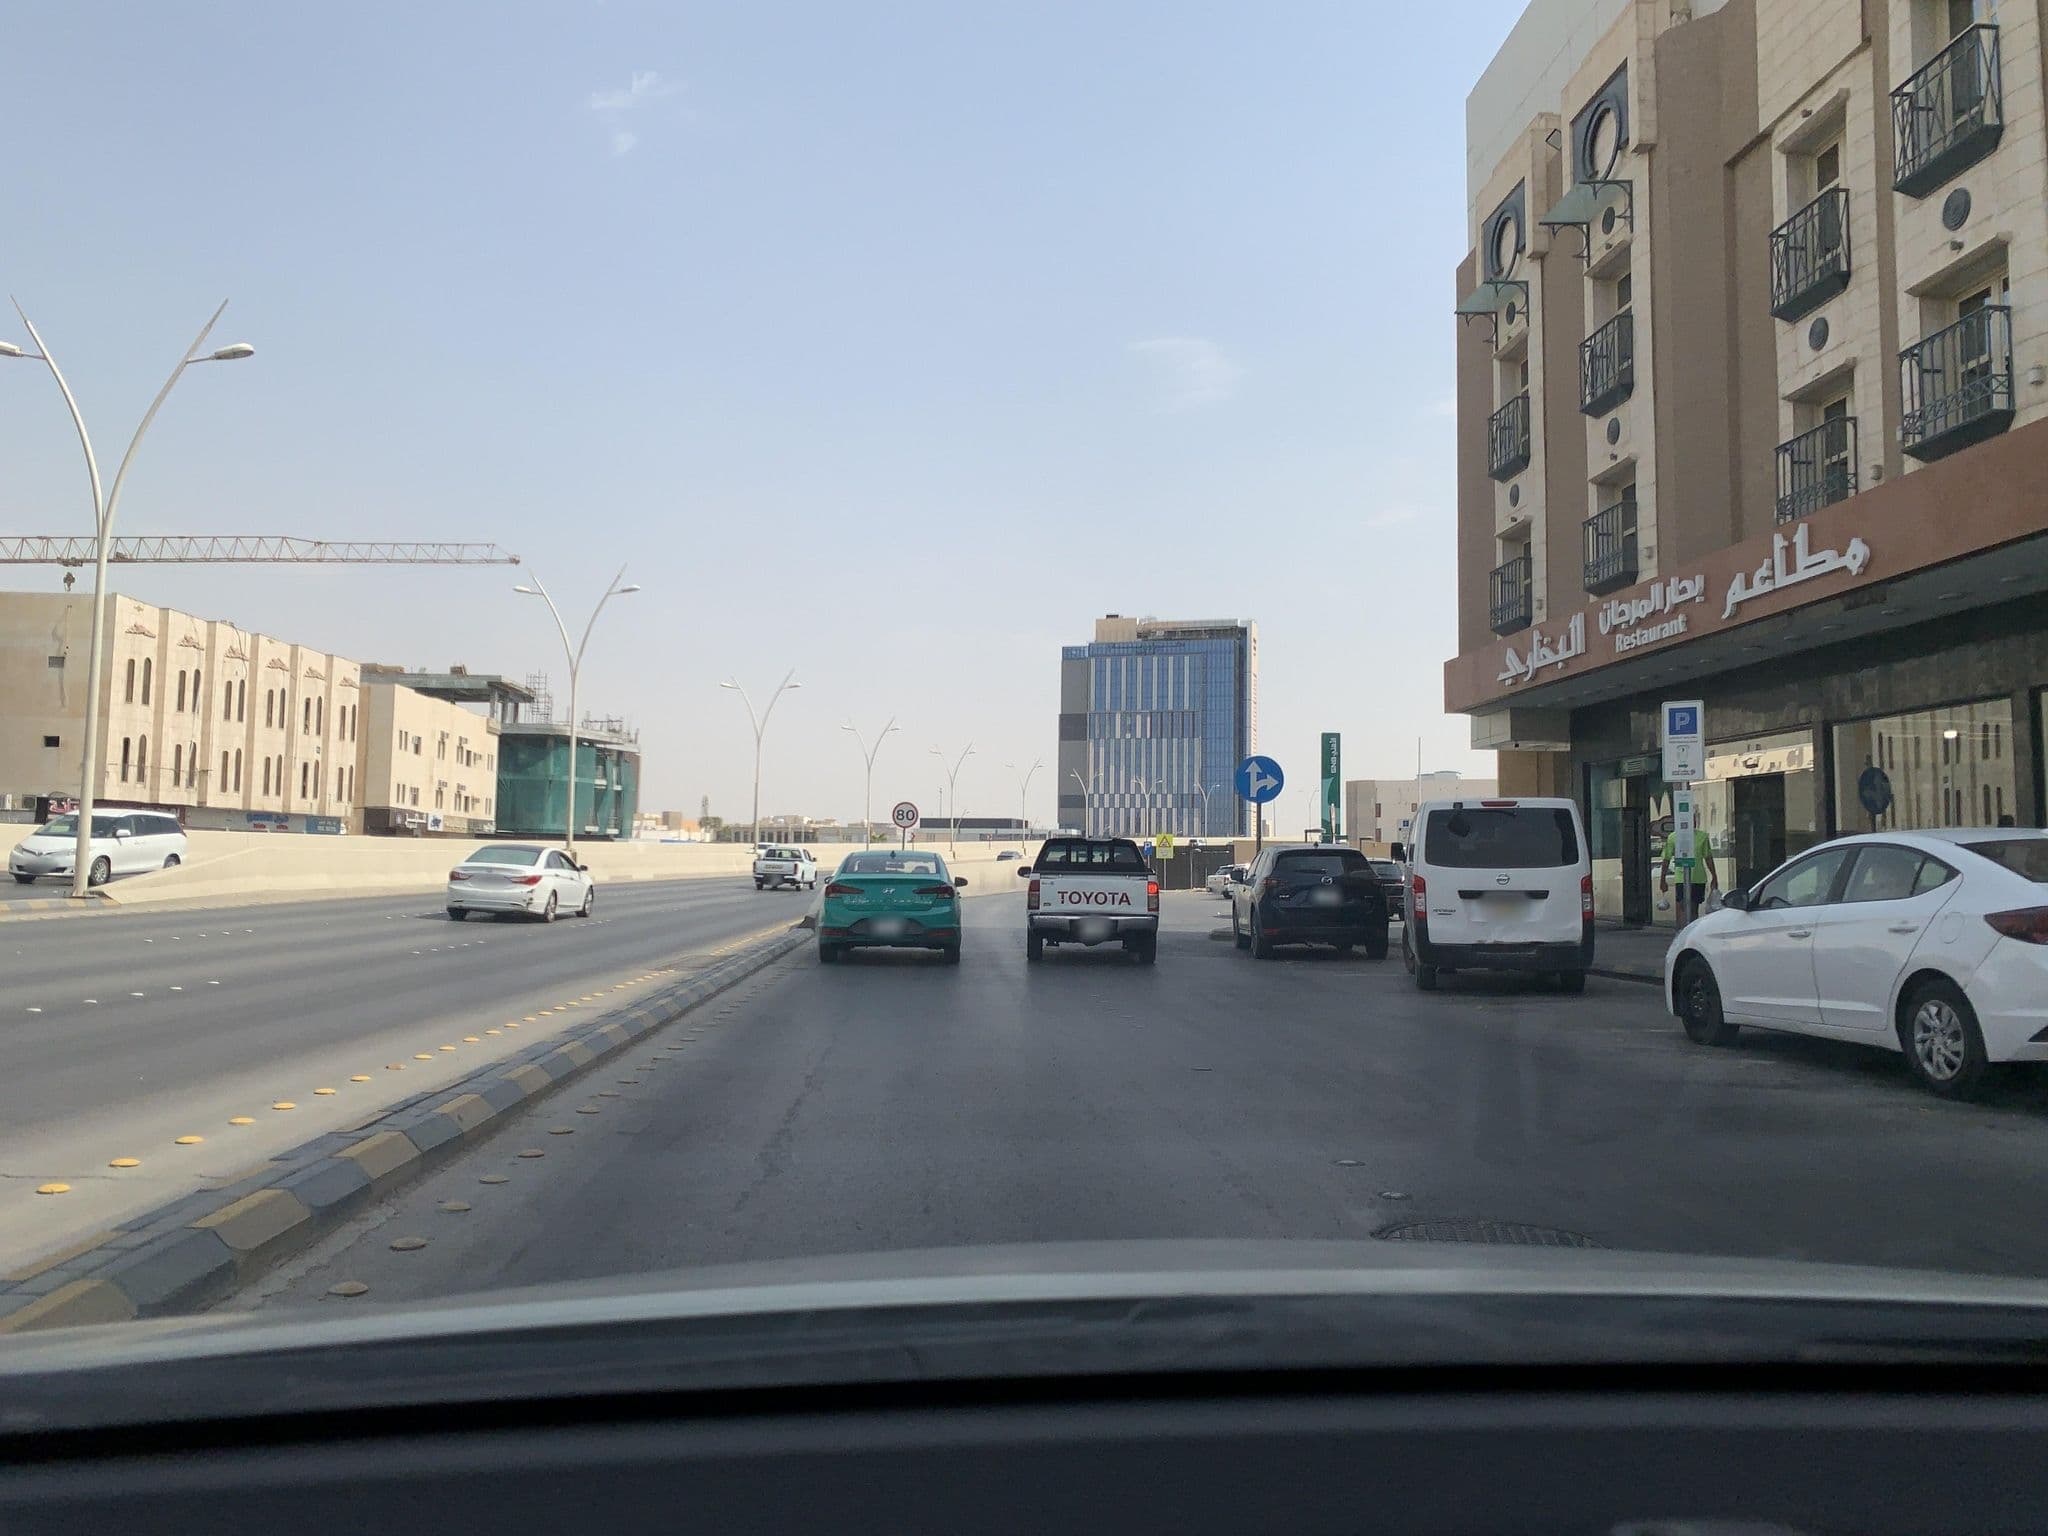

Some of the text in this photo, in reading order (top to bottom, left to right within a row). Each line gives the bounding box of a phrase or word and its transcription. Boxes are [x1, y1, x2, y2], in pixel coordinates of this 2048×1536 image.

[1721, 522, 1871, 620] مطاعم
[1599, 582, 1664, 635] المرجان
[1496, 612, 1586, 686] البخاري
[1615, 613, 1688, 653] Restaurant
[1675, 712, 1690, 731] P
[896, 809, 915, 821] 80
[1057, 891, 1132, 906] TOYOTA
